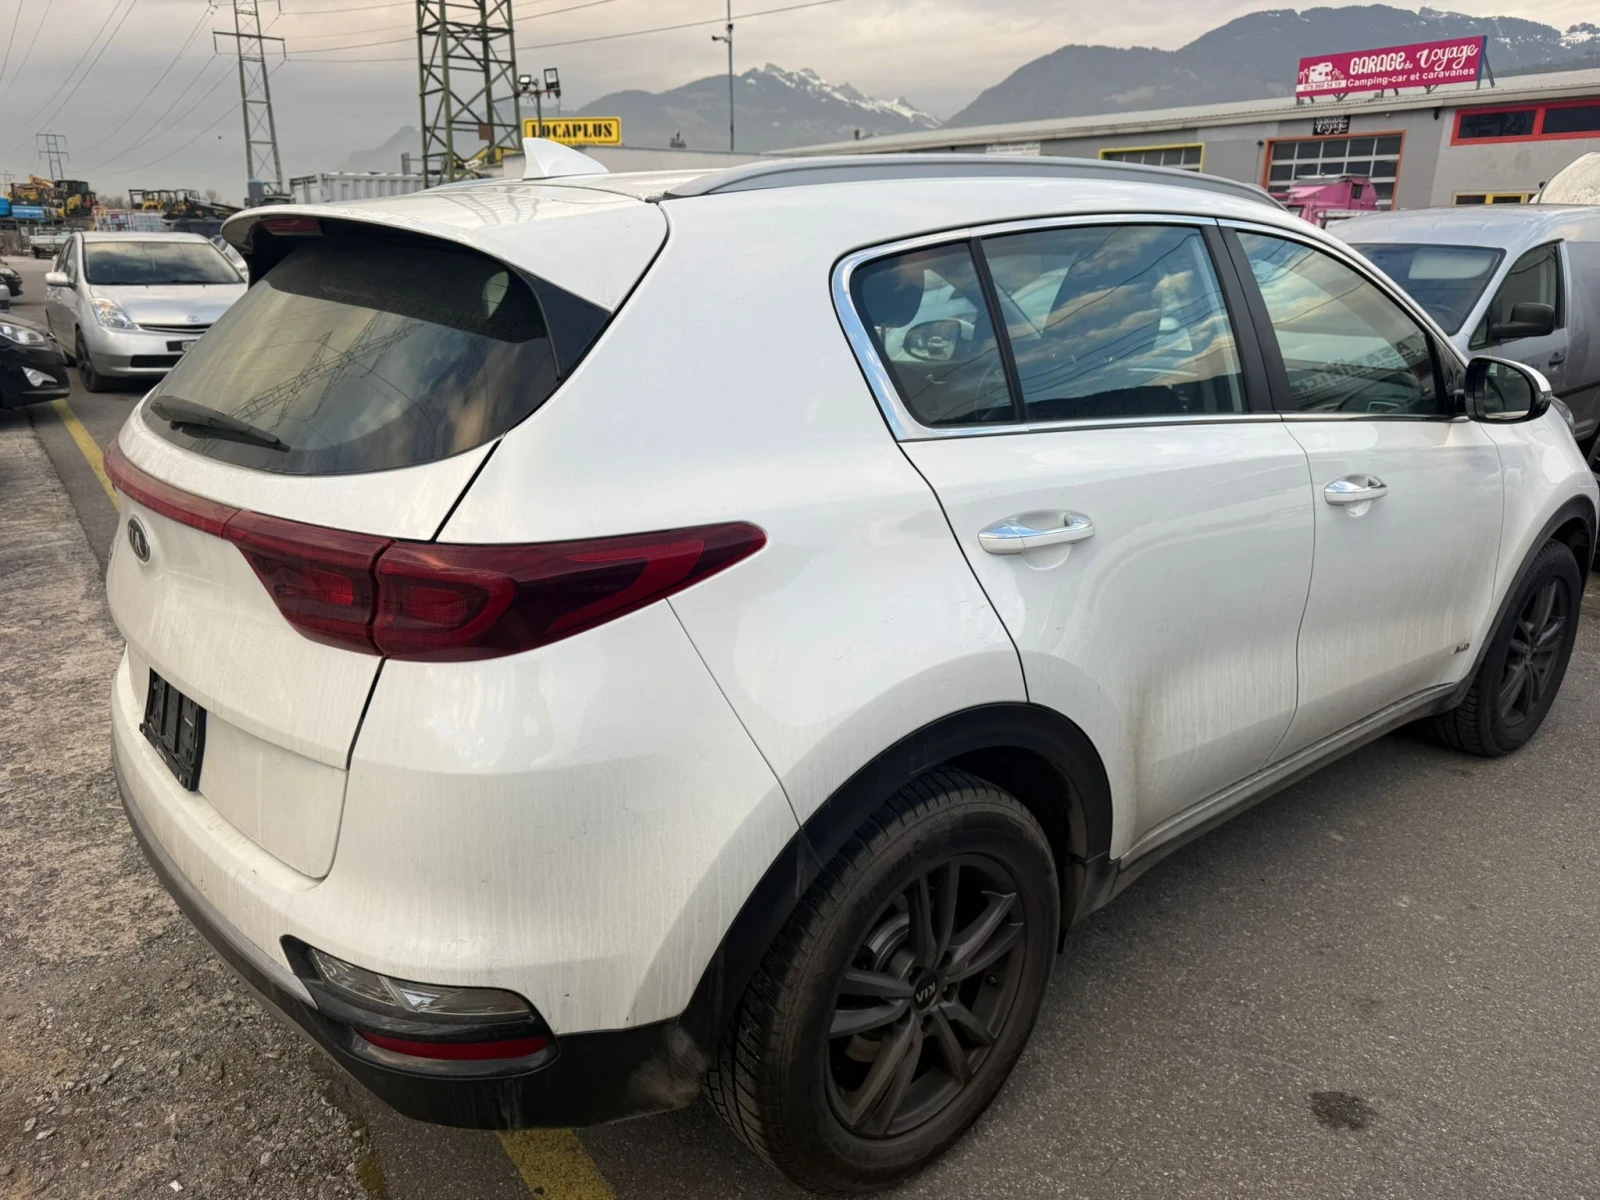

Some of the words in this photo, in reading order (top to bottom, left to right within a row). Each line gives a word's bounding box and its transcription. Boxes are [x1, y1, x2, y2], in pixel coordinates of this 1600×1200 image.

[1404, 60, 1414, 70] du
[1416, 44, 1479, 72] Voyage
[1347, 75, 1408, 87] Camping-car
[1409, 72, 1420, 81] et
[1422, 67, 1475, 80] caravanes
[531, 122, 613, 138] LOCAPLUS
[915, 982, 936, 1003] KIA
